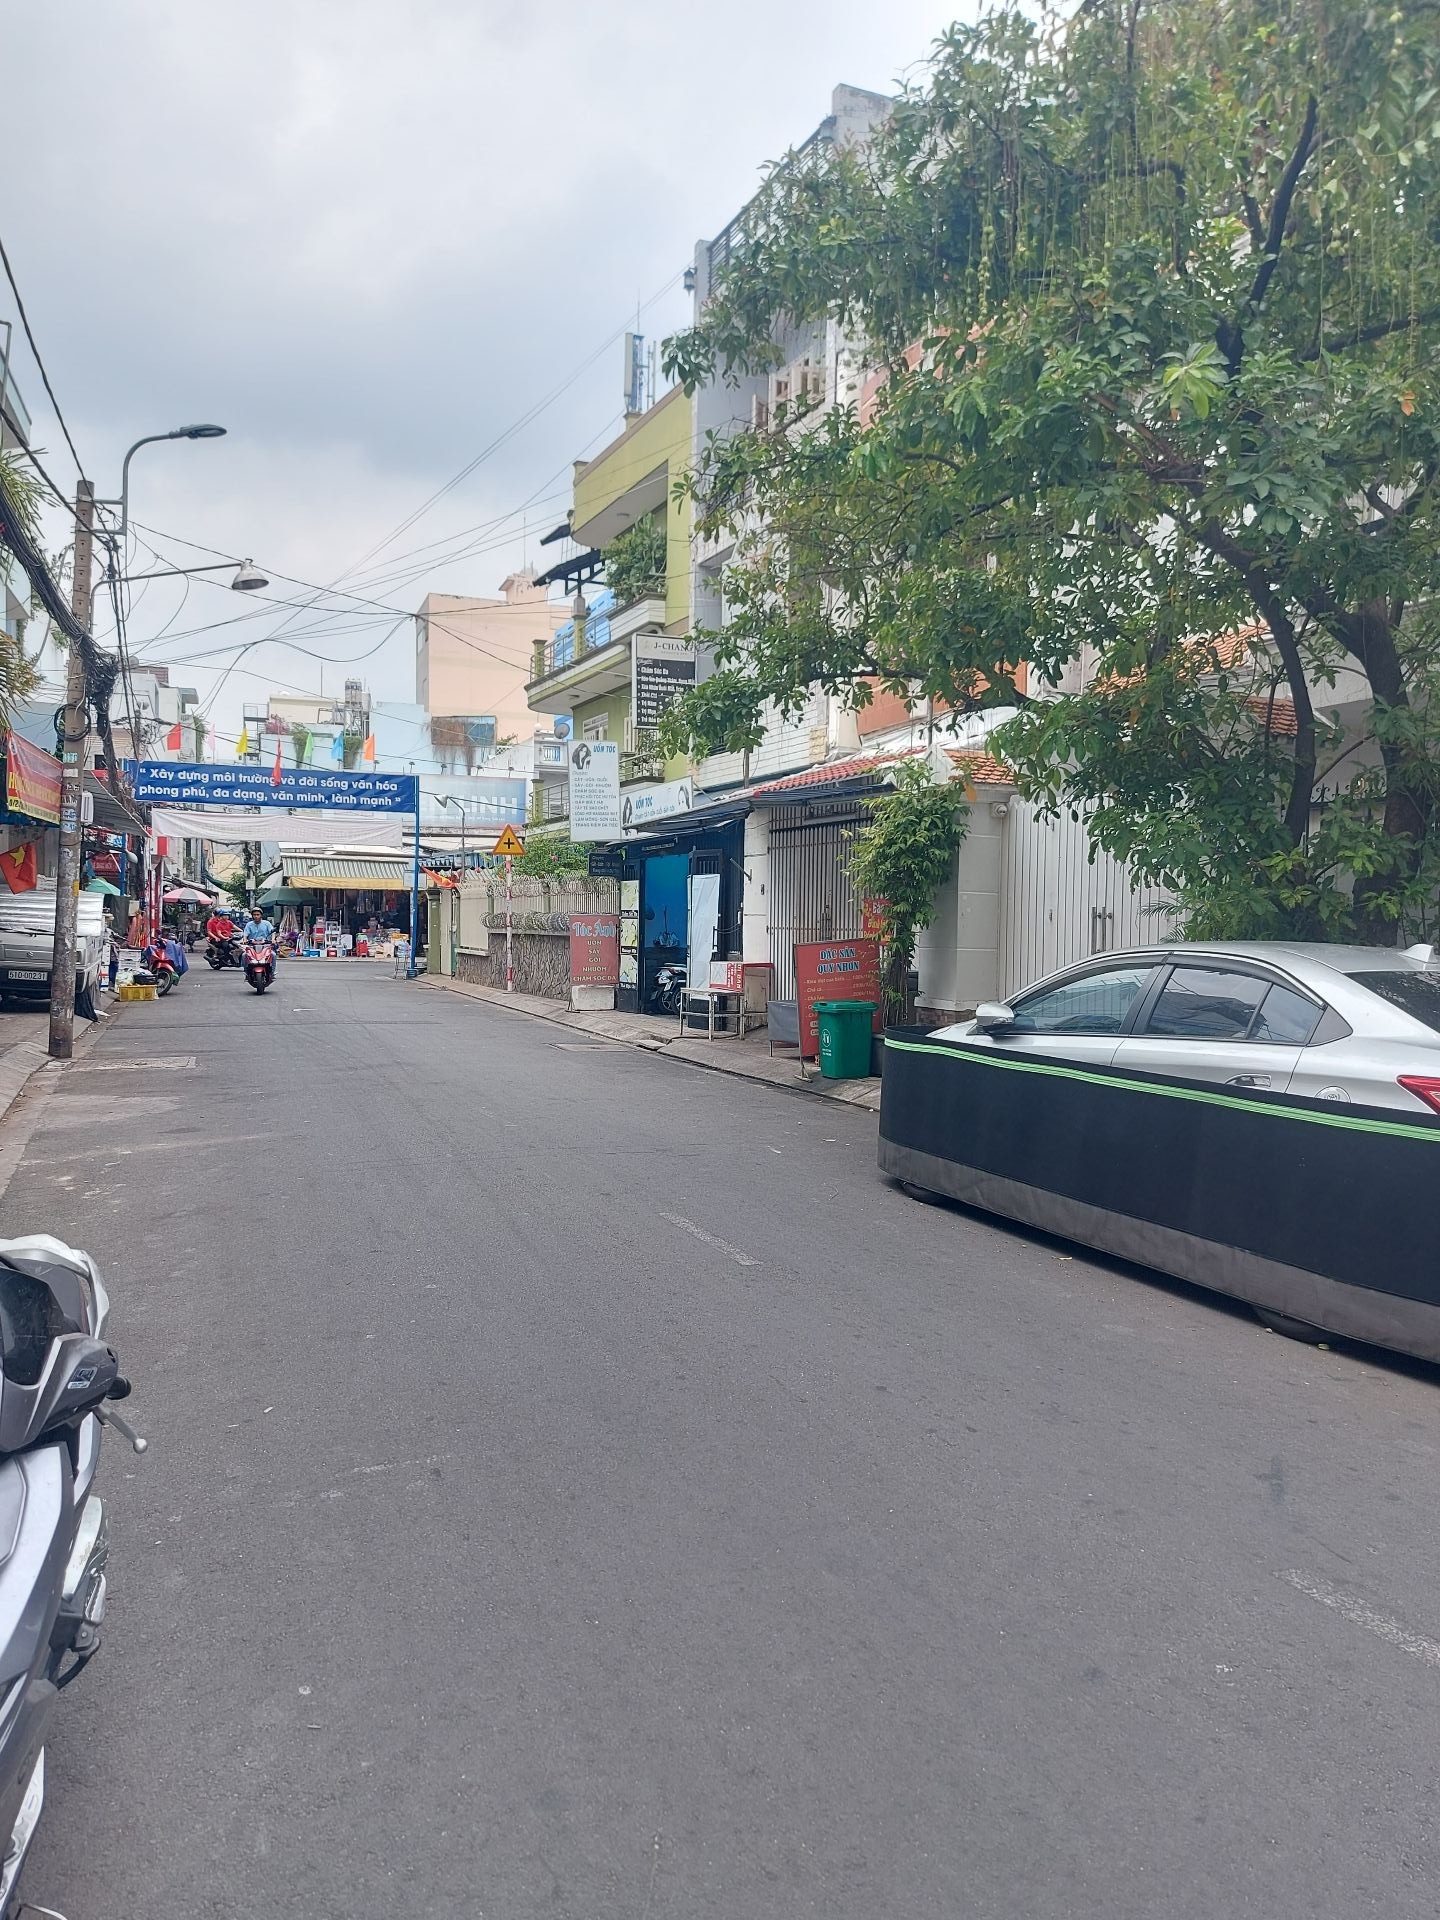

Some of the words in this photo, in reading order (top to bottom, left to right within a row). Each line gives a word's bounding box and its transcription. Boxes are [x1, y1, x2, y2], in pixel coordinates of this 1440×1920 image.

[150, 768, 174, 780] Xây
[178, 771, 209, 782] dựng
[213, 772, 235, 782] môi
[281, 776, 295, 786] và
[299, 777, 318, 787] đời
[320, 777, 349, 790] sống
[352, 780, 373, 790] văn
[376, 781, 398, 791] hóa
[139, 785, 179, 797] phong
[182, 787, 209, 798] phú,
[213, 788, 230, 798] đa
[233, 789, 268, 801] dạng,
[271, 790, 293, 800] văn
[297, 792, 328, 804] minh,
[332, 793, 357, 804] lành
[360, 797, 392, 807] mạnh
